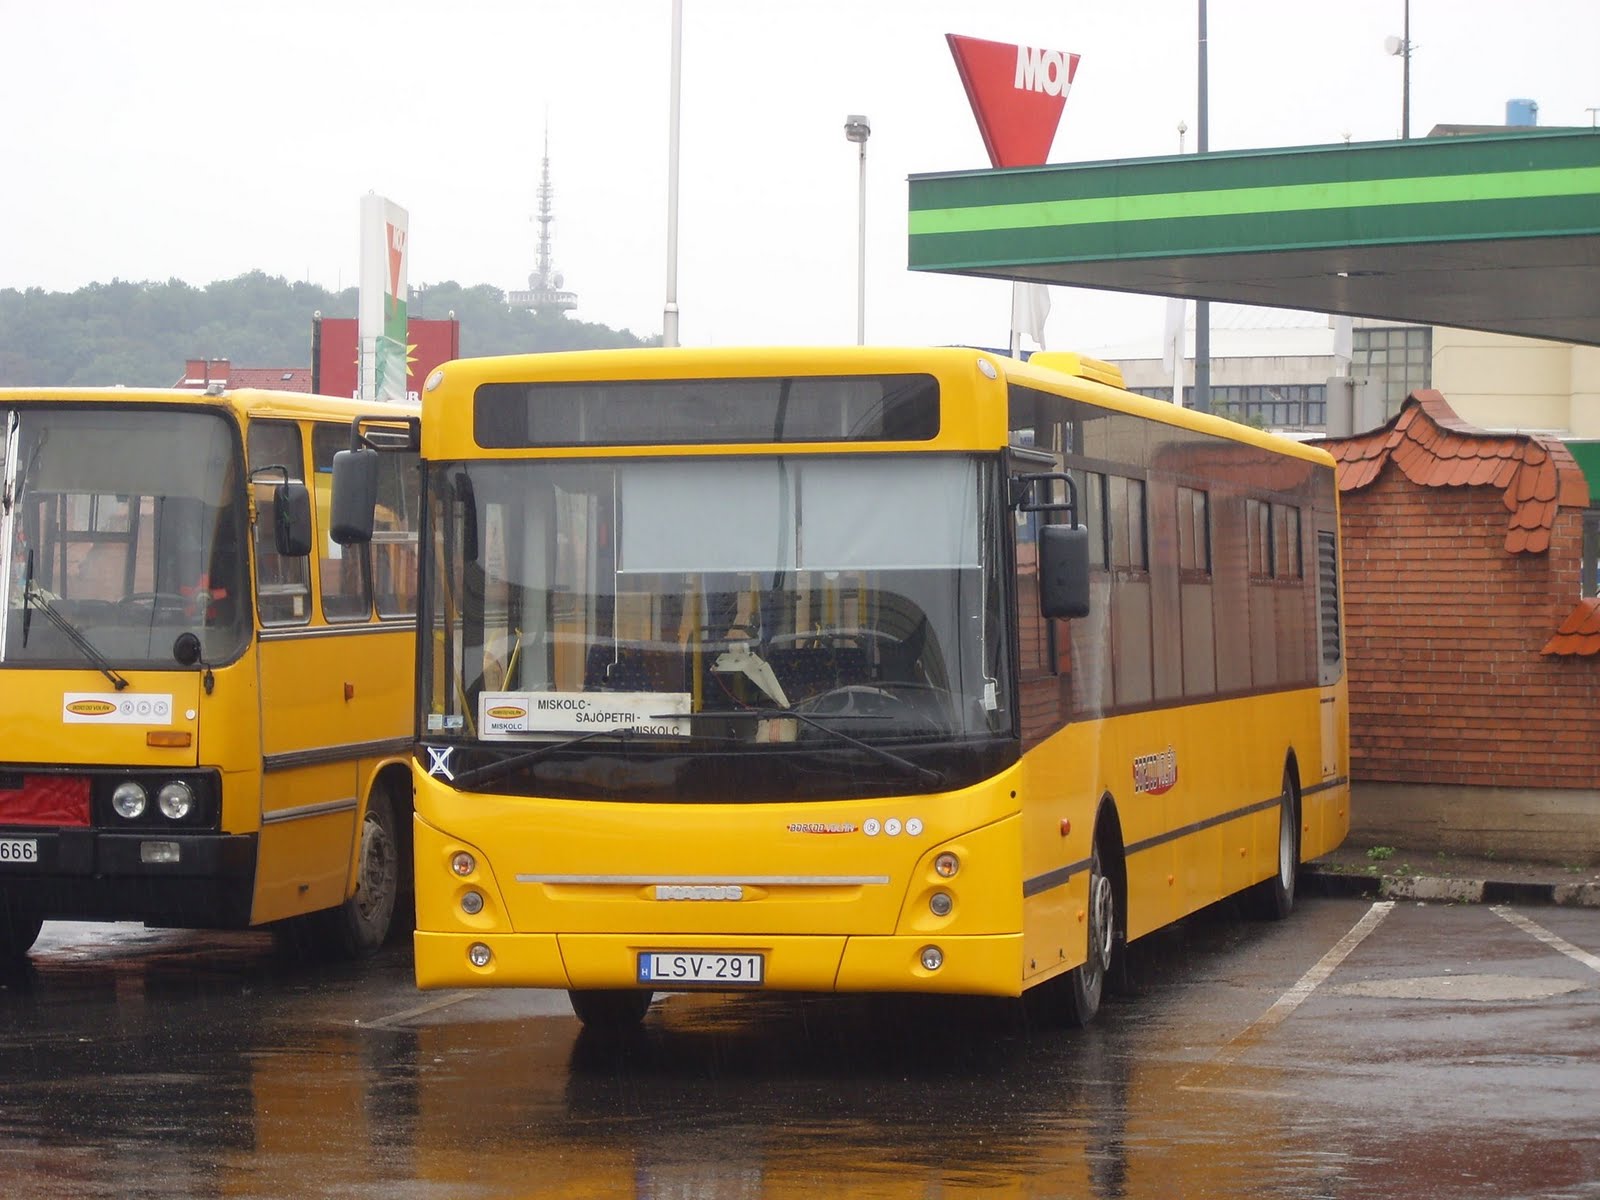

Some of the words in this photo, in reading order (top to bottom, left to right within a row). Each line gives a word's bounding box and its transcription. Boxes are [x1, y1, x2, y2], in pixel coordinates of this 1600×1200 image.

[1014, 45, 1071, 98] MOL
[790, 823, 825, 833] BORSOD
[655, 956, 755, 979] LSV-291
